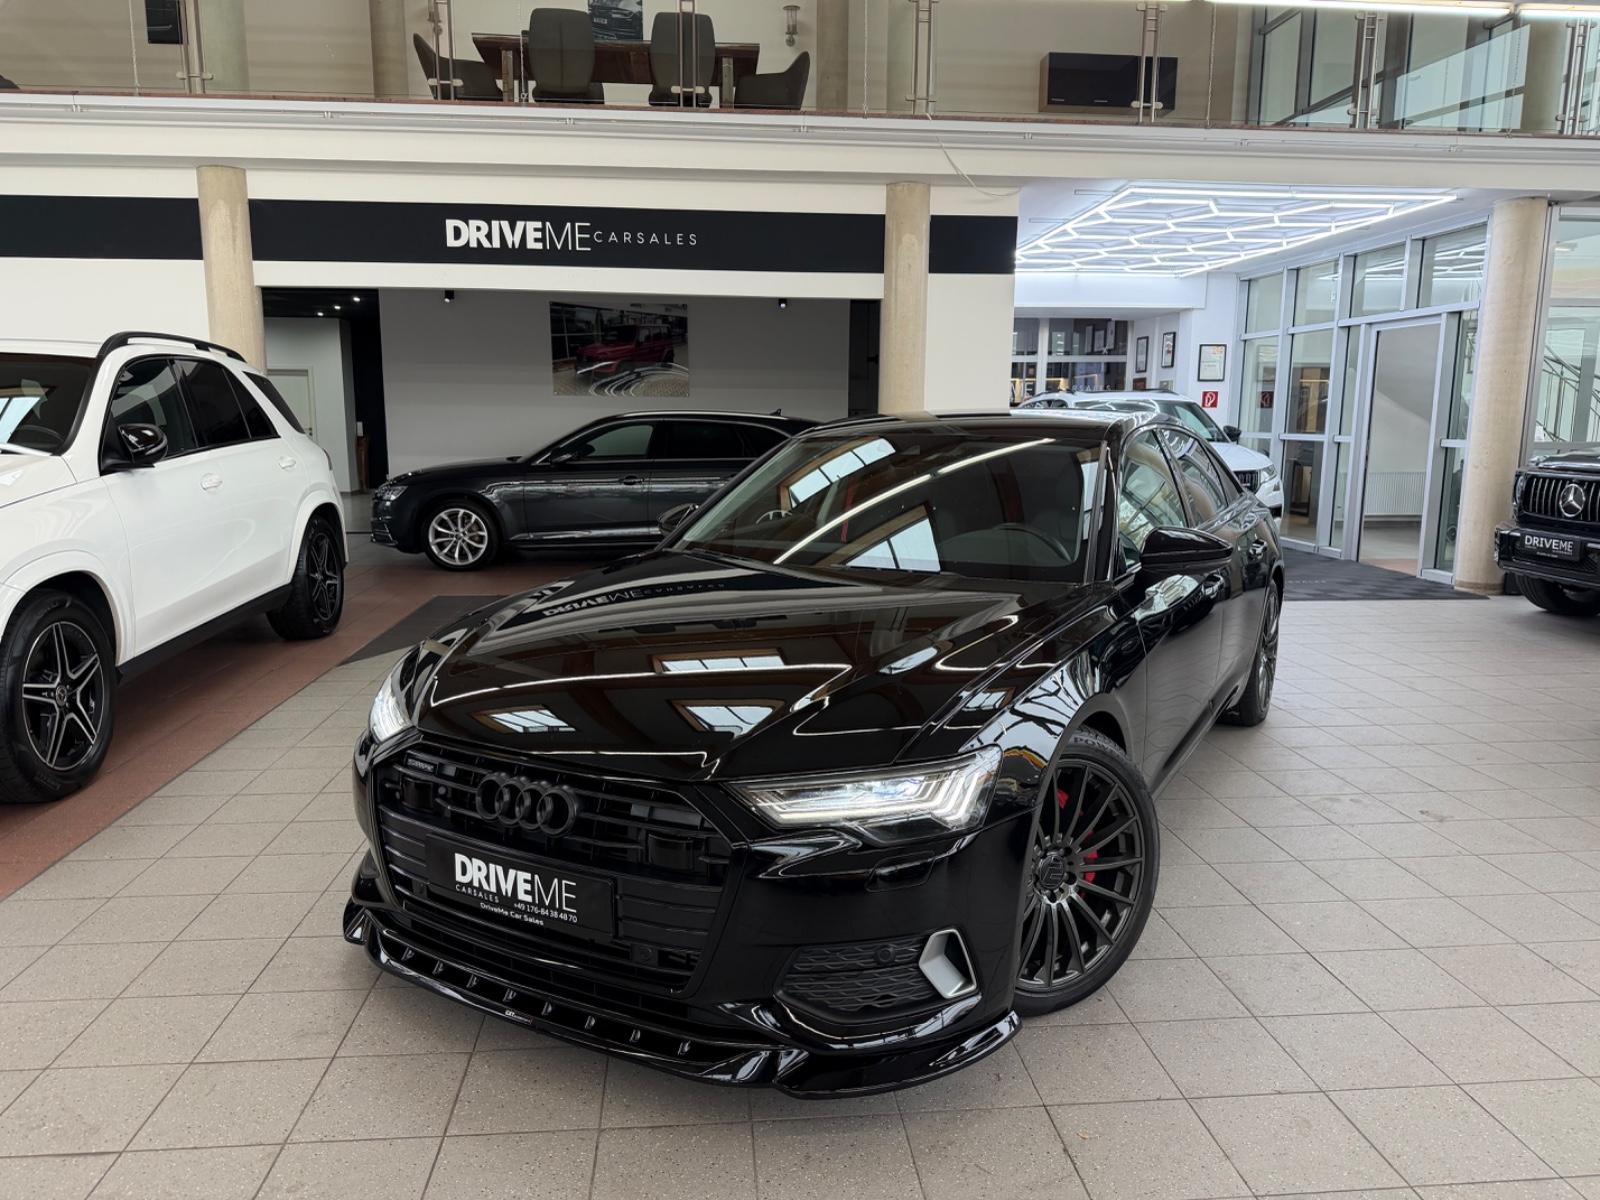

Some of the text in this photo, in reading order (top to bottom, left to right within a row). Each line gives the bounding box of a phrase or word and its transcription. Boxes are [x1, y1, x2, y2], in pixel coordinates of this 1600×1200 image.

[445, 218, 698, 251] DRIVEME CARSALES
[1525, 535, 1574, 552] DRIVEME
[455, 853, 577, 913] DRIVEME
[455, 884, 499, 903] CARSALES
[510, 911, 522, 920] Car
[524, 915, 544, 925] Sales
[568, 914, 578, 924] 70
